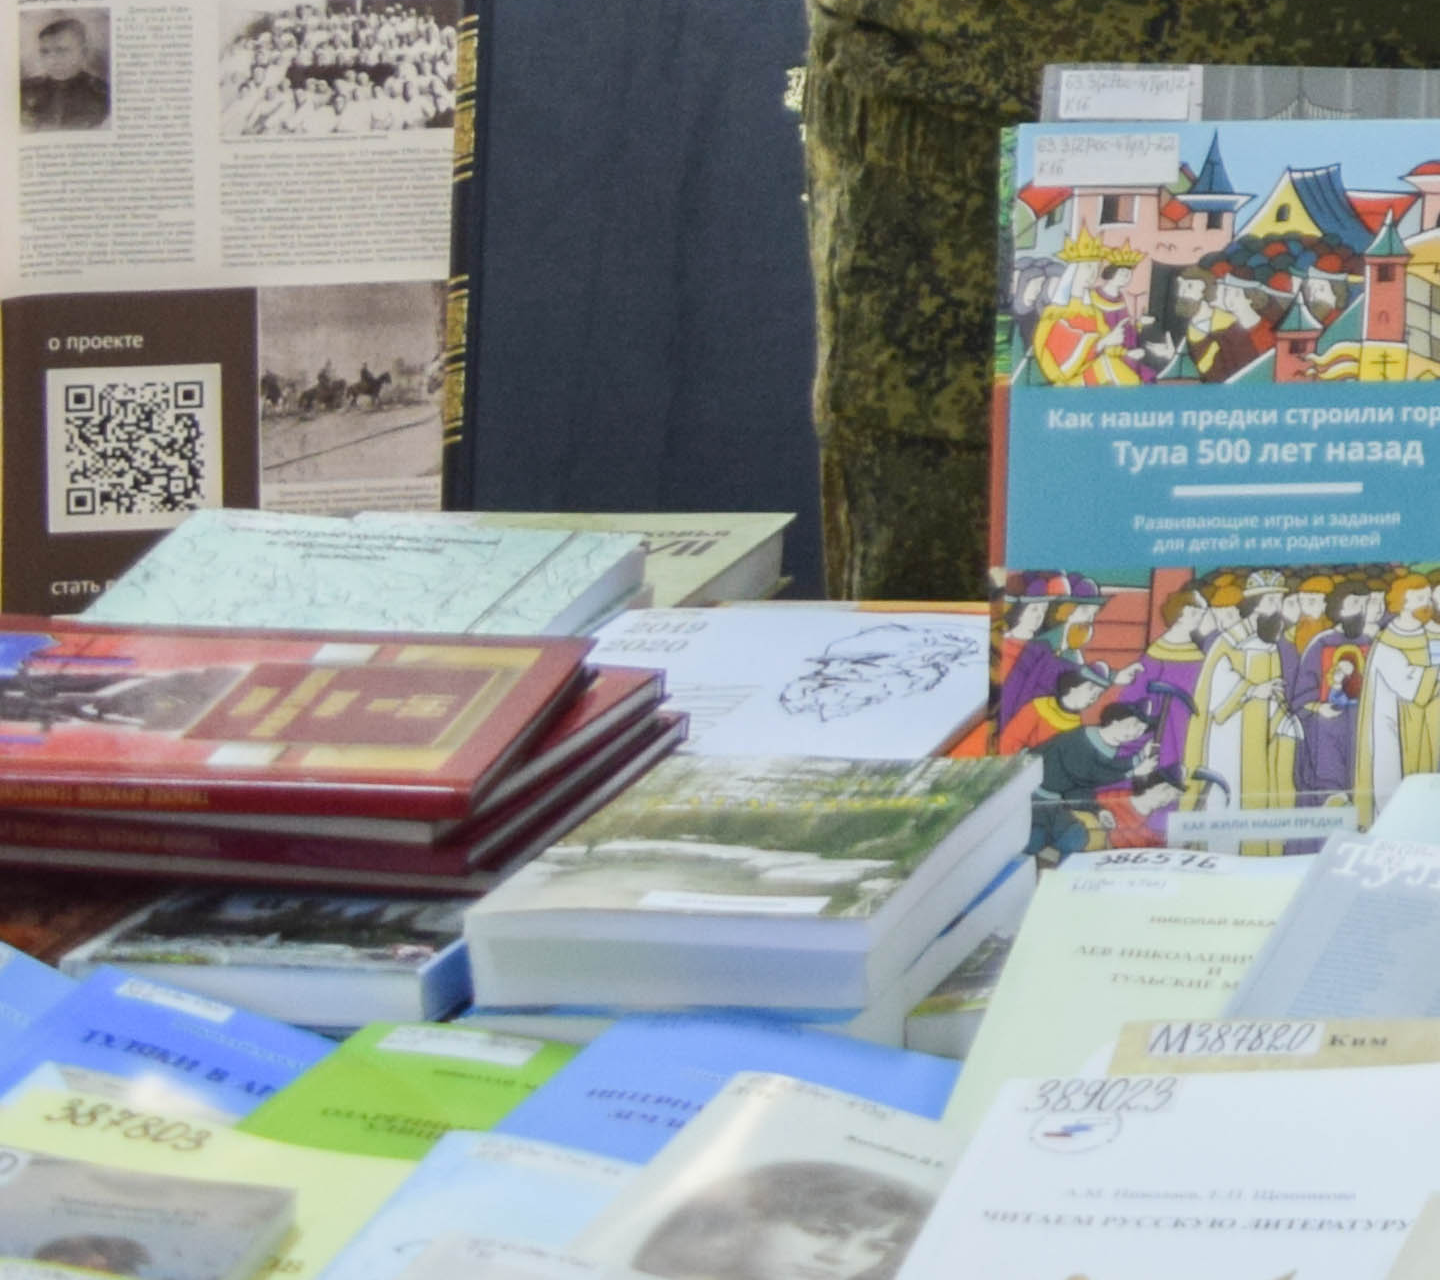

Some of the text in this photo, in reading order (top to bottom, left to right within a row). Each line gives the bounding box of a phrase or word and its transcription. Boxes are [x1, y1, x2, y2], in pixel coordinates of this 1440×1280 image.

[48, 332, 145, 355] о проекте
[1047, 408, 1094, 429] Как
[1102, 409, 1174, 428] наши
[1181, 408, 1278, 432] предки
[1285, 406, 1394, 426] строили
[1112, 438, 1425, 473] Тула 500 лет назад
[1263, 514, 1308, 533] игры
